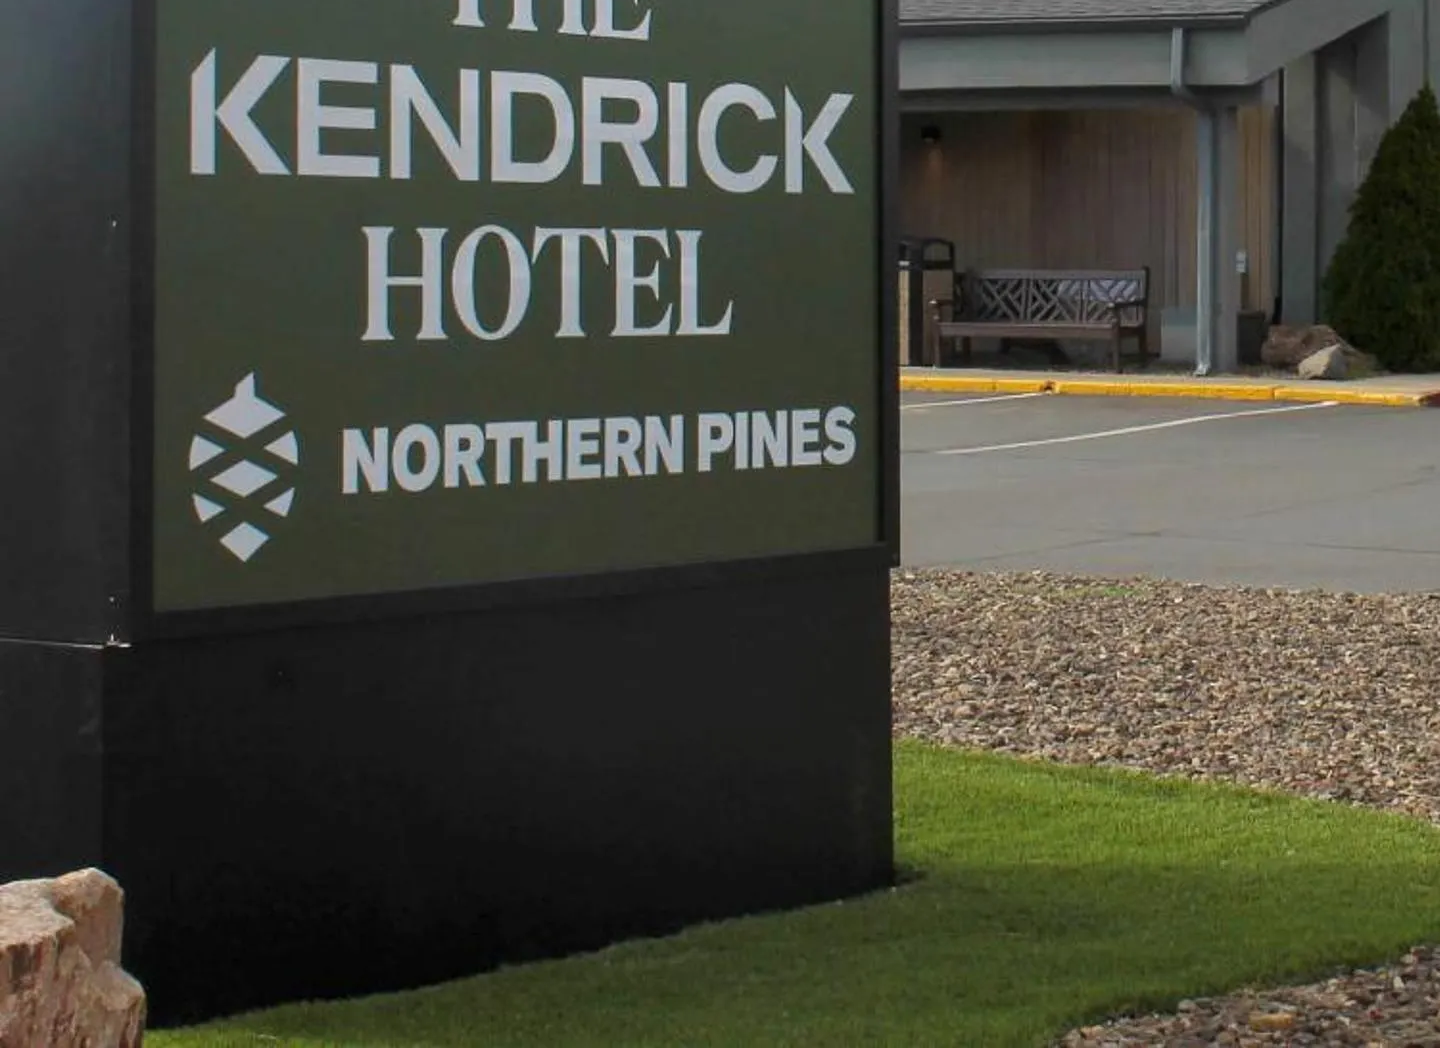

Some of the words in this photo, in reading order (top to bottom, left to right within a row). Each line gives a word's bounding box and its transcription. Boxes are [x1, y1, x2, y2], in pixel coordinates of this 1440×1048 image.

[190, 47, 854, 194] KENDRICK
[361, 224, 733, 341] HOTEL
[342, 414, 684, 494] NORTHERN
[697, 406, 857, 473] PINES
